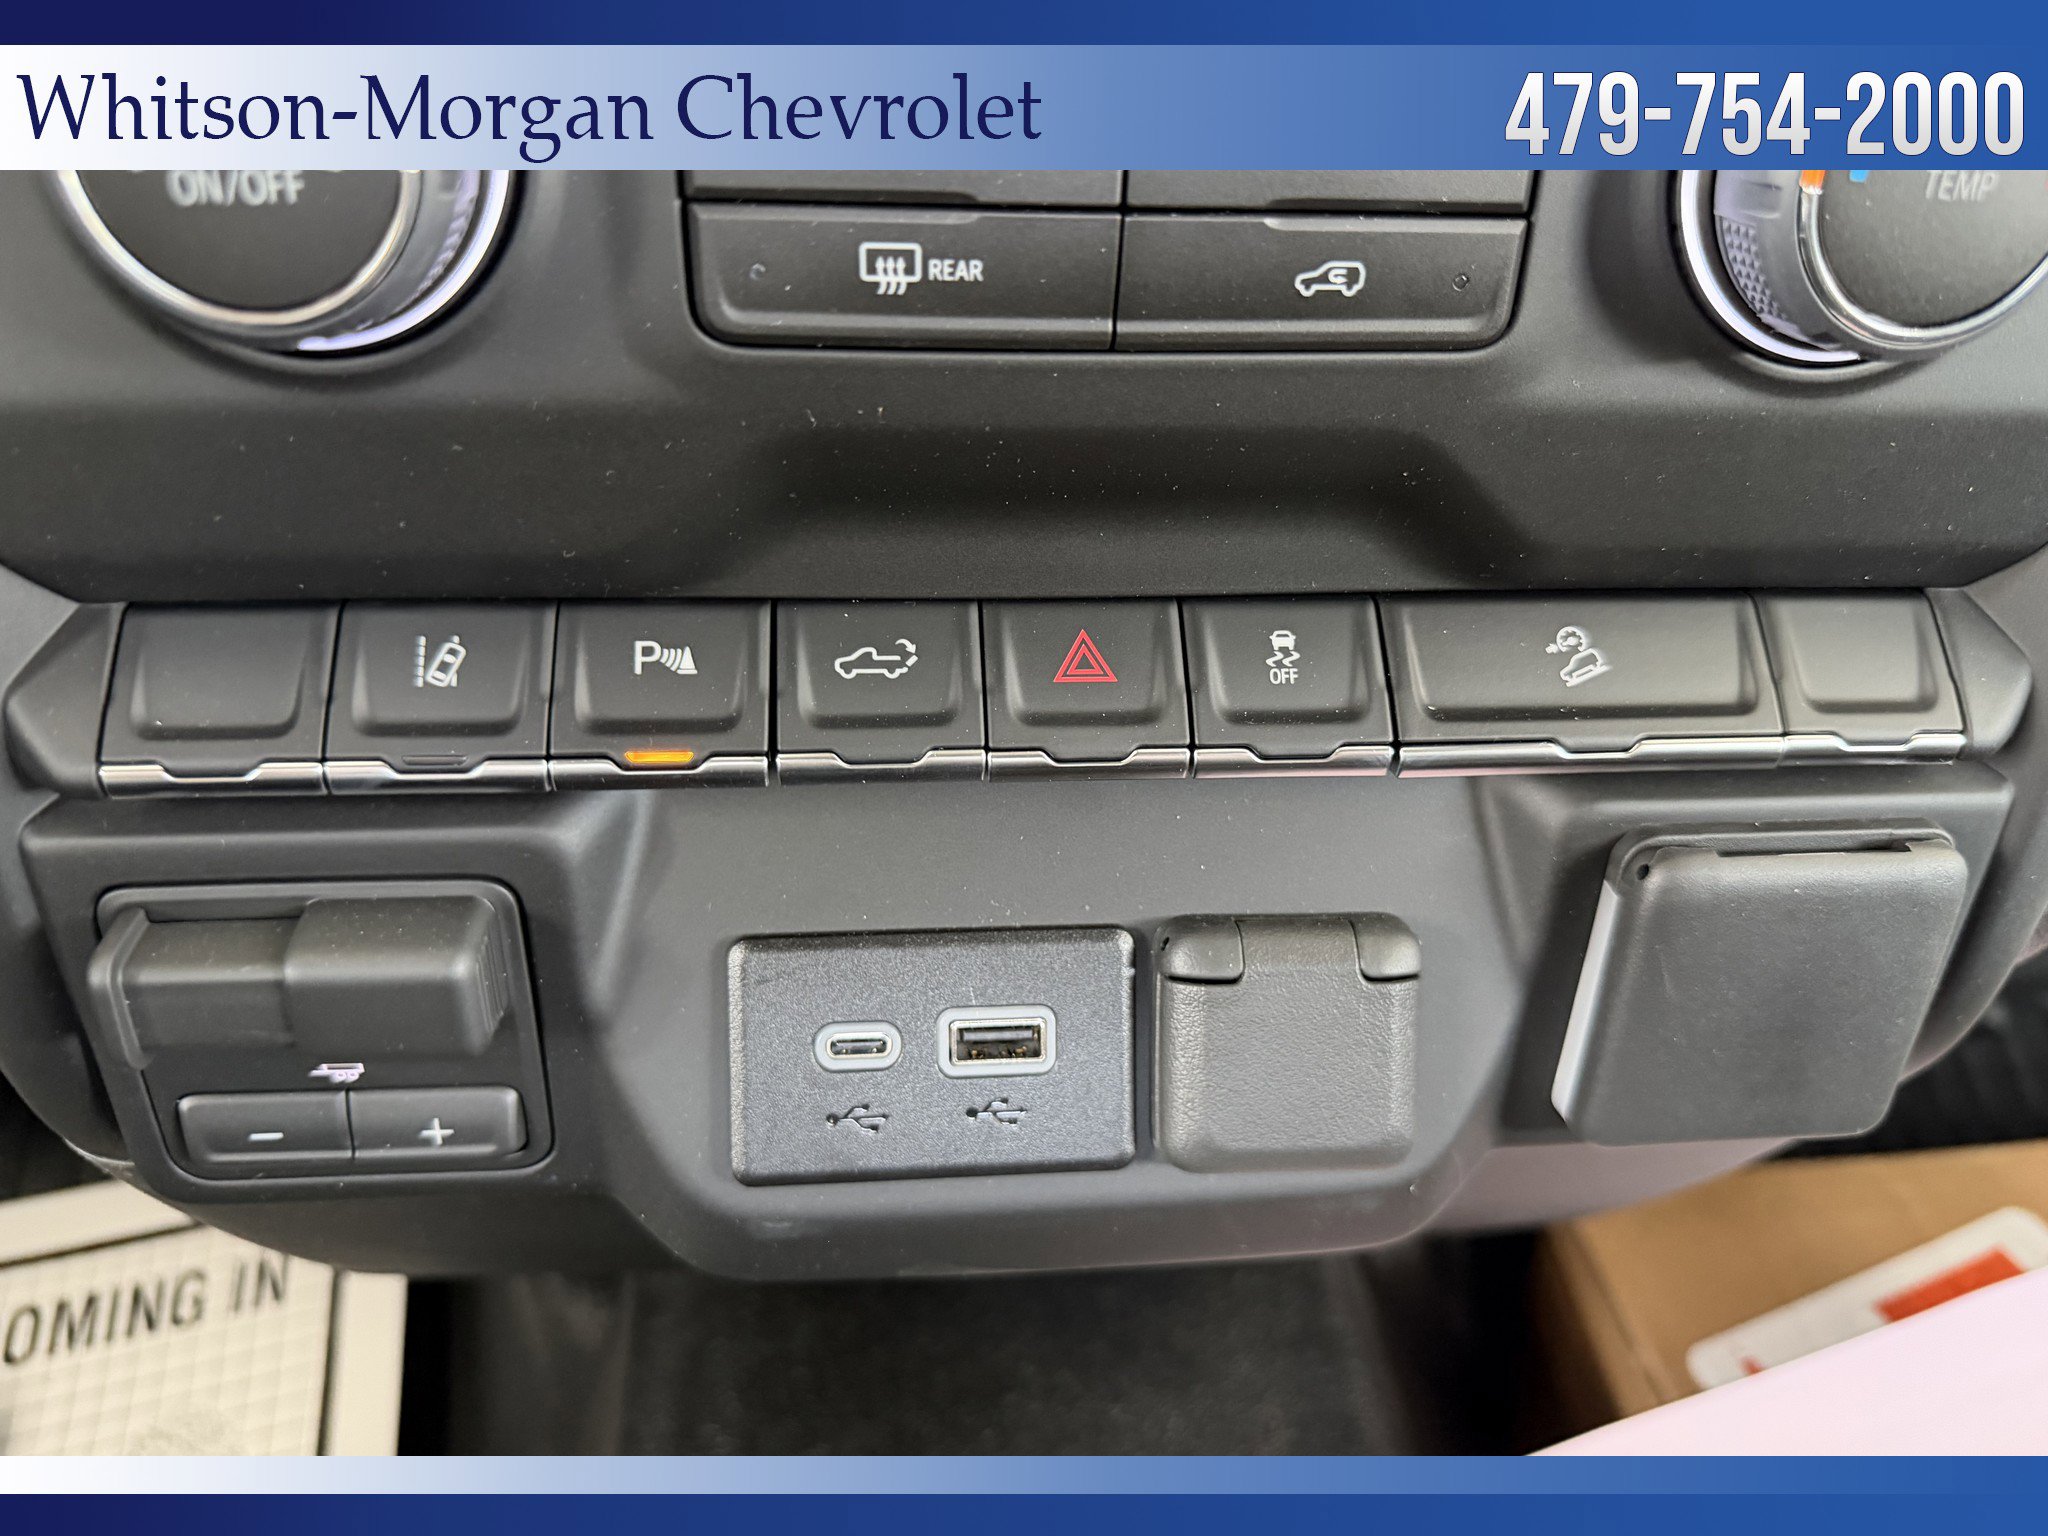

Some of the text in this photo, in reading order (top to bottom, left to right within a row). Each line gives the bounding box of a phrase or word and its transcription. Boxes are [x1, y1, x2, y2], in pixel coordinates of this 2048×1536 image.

[167, 170, 304, 206] ON/OFF
[1924, 170, 1998, 201] TEMP
[927, 258, 984, 283] REAR
[1268, 668, 1299, 685] OFF
[3, 1253, 290, 1365] OMING IN
